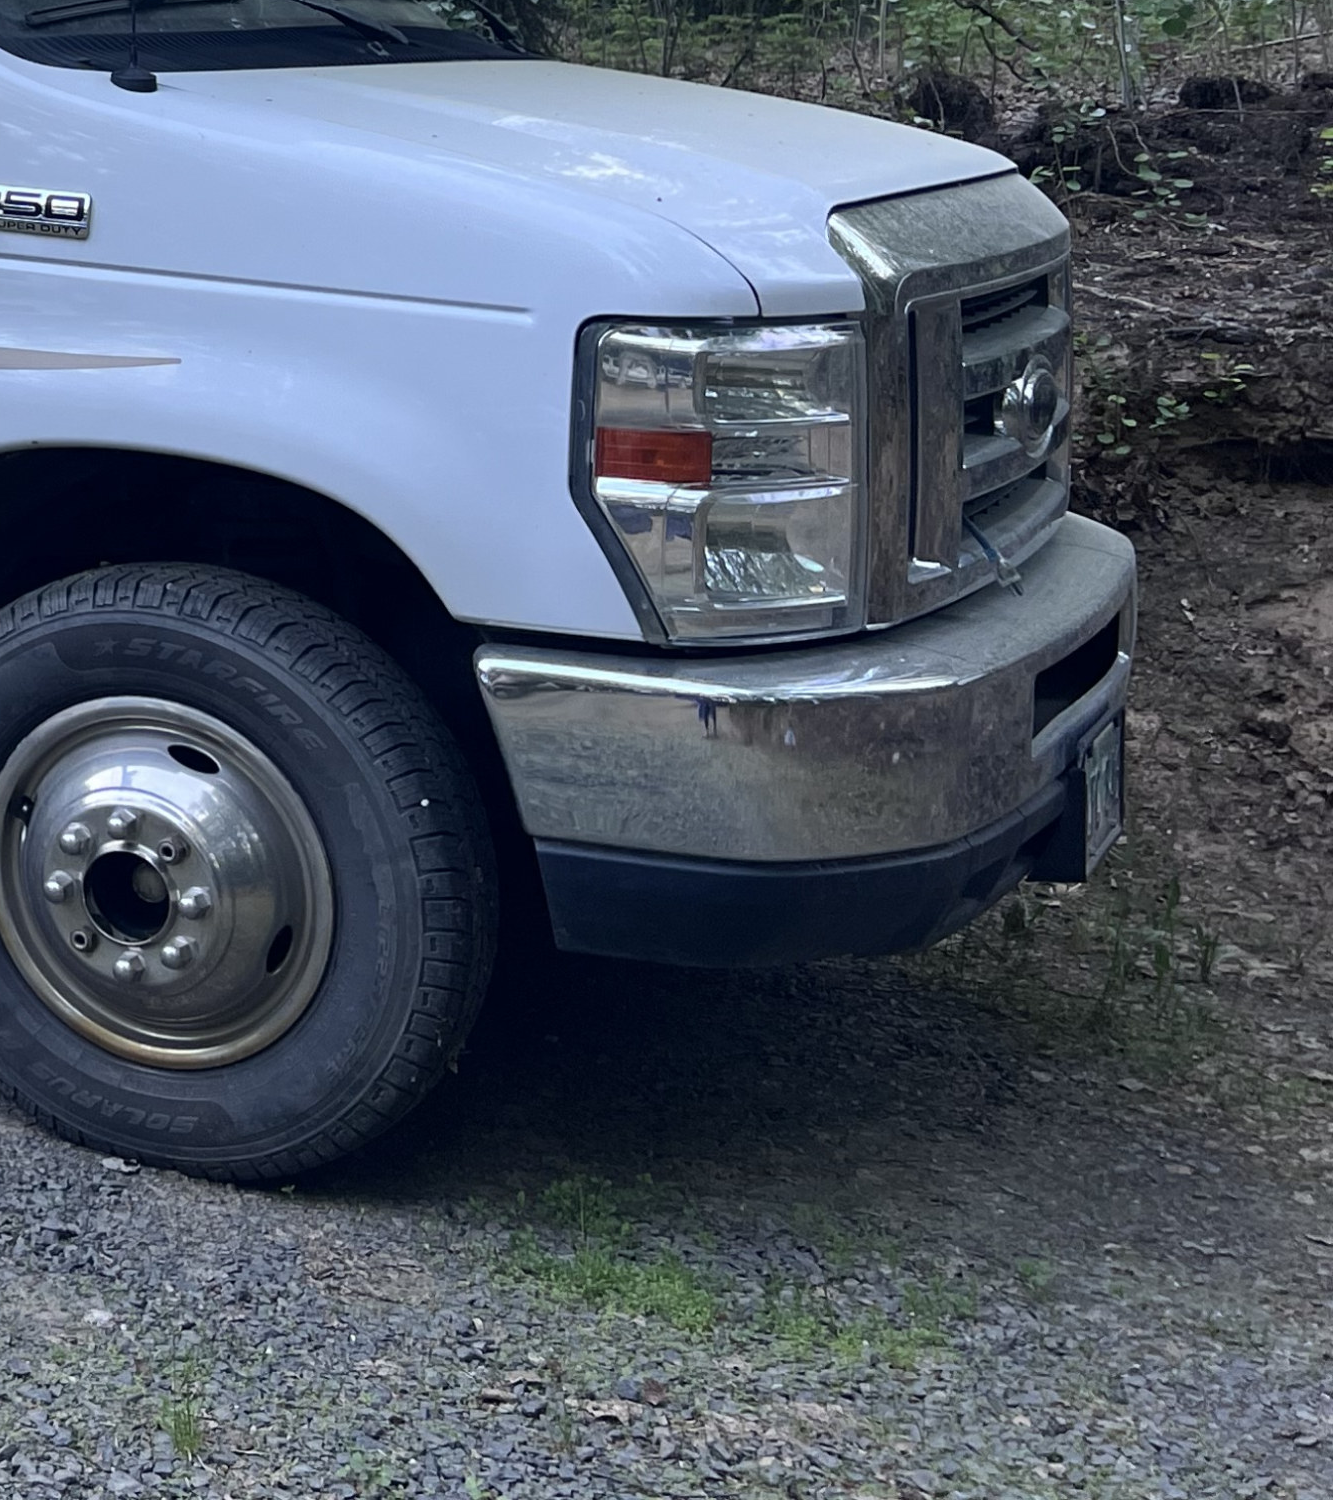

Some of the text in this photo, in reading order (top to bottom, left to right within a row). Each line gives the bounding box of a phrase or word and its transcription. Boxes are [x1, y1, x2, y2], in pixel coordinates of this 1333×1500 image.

[40, 224, 83, 237] DUTY
[122, 637, 329, 752] STARFIRE
[27, 1061, 200, 1133] SOLARUS
